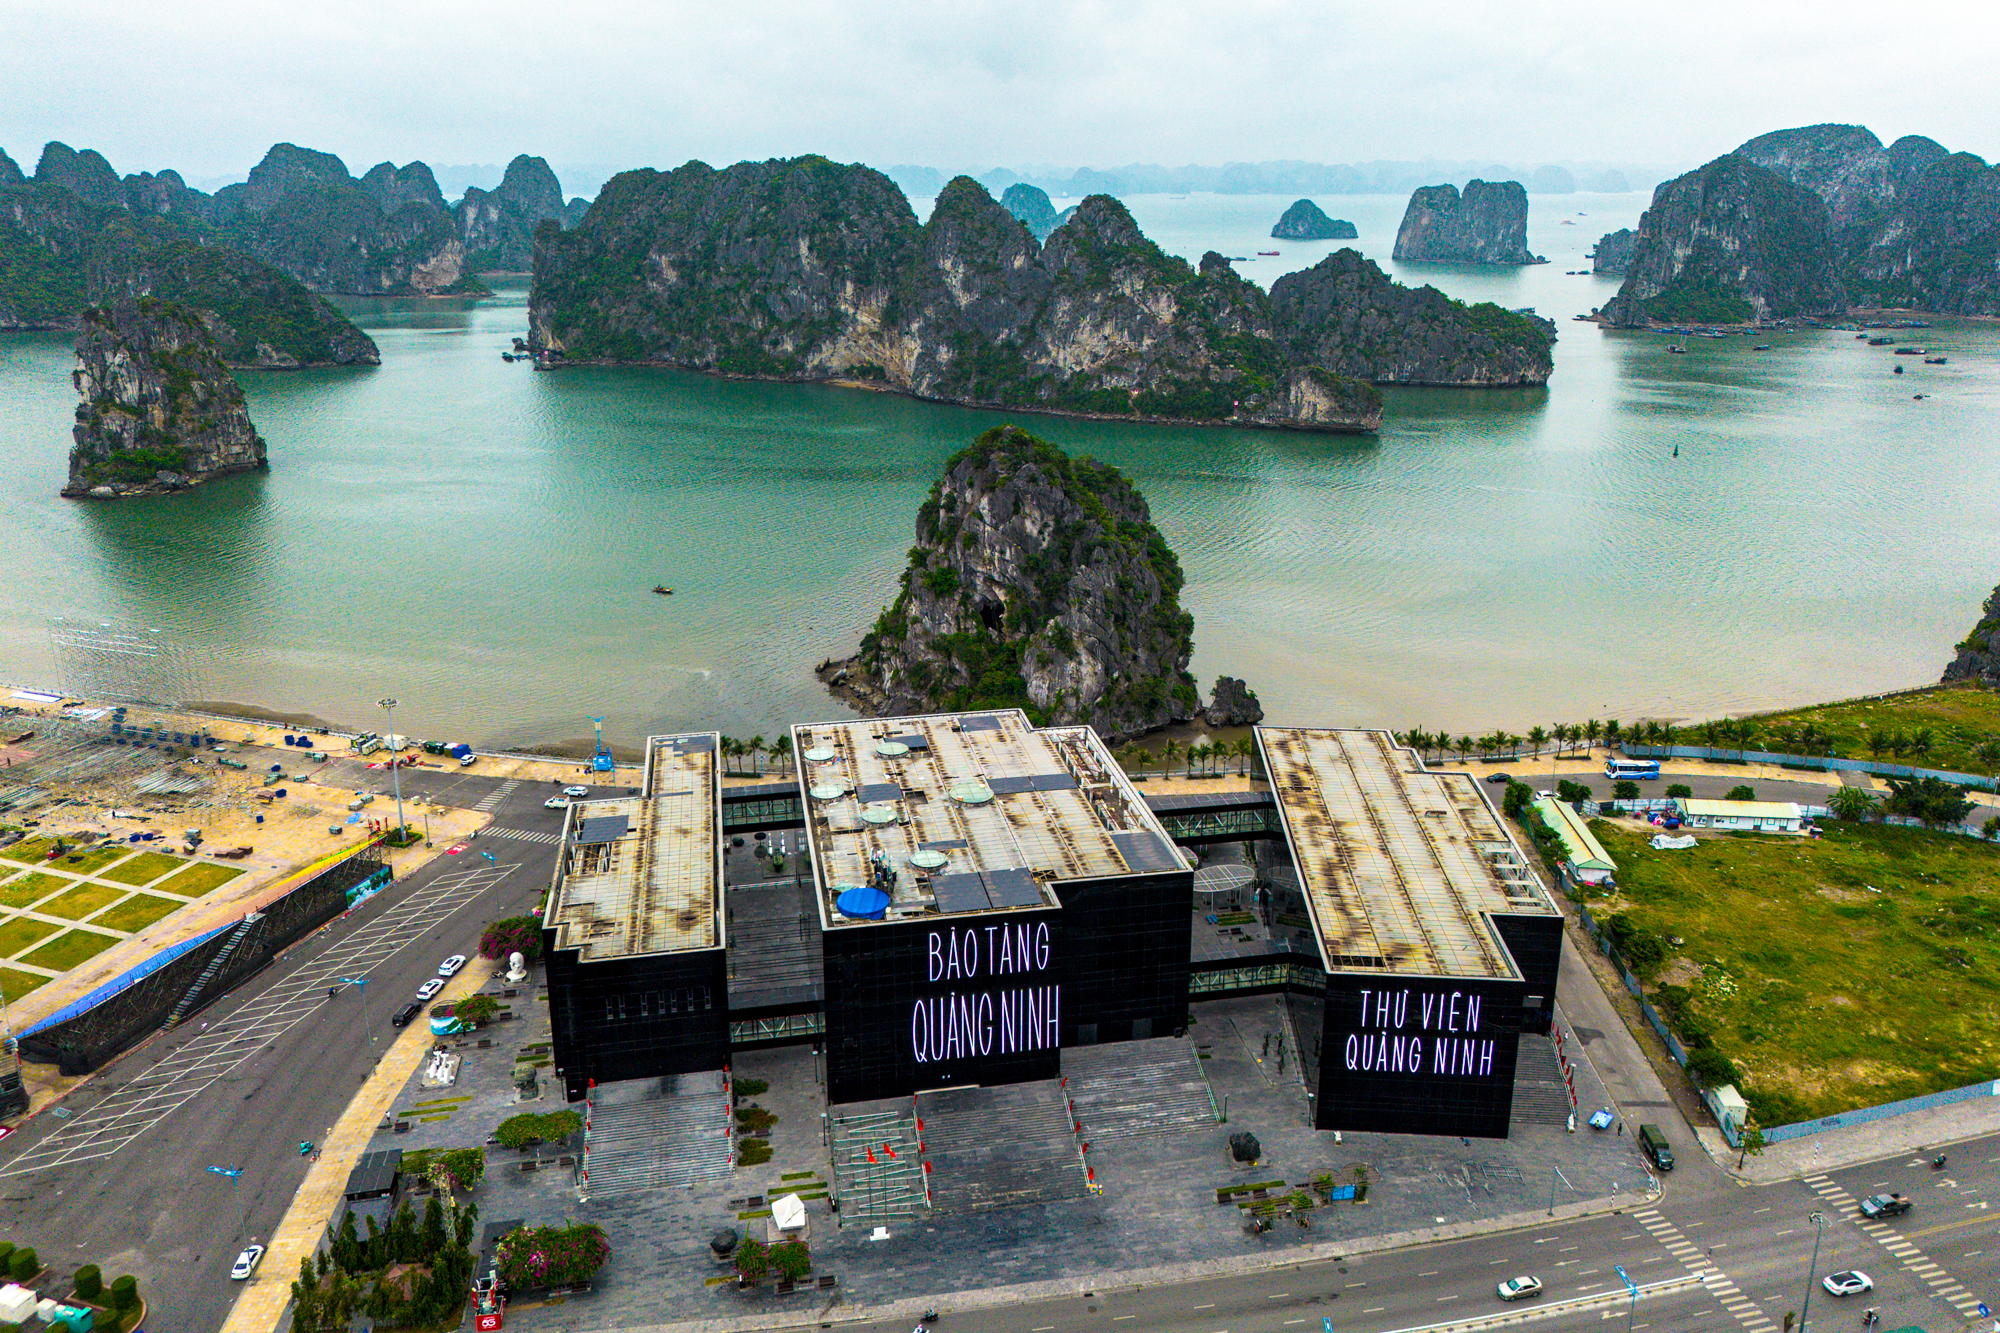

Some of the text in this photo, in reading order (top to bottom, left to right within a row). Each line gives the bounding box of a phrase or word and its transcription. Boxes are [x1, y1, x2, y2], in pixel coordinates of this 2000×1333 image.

[929, 922, 1048, 981] BẢO TÀNG
[912, 985, 1059, 1062] QUẢNG NINH
[1361, 990, 1480, 1033] THƯ VIỆN
[1346, 1031, 1494, 1076] QUẢNG NINH
